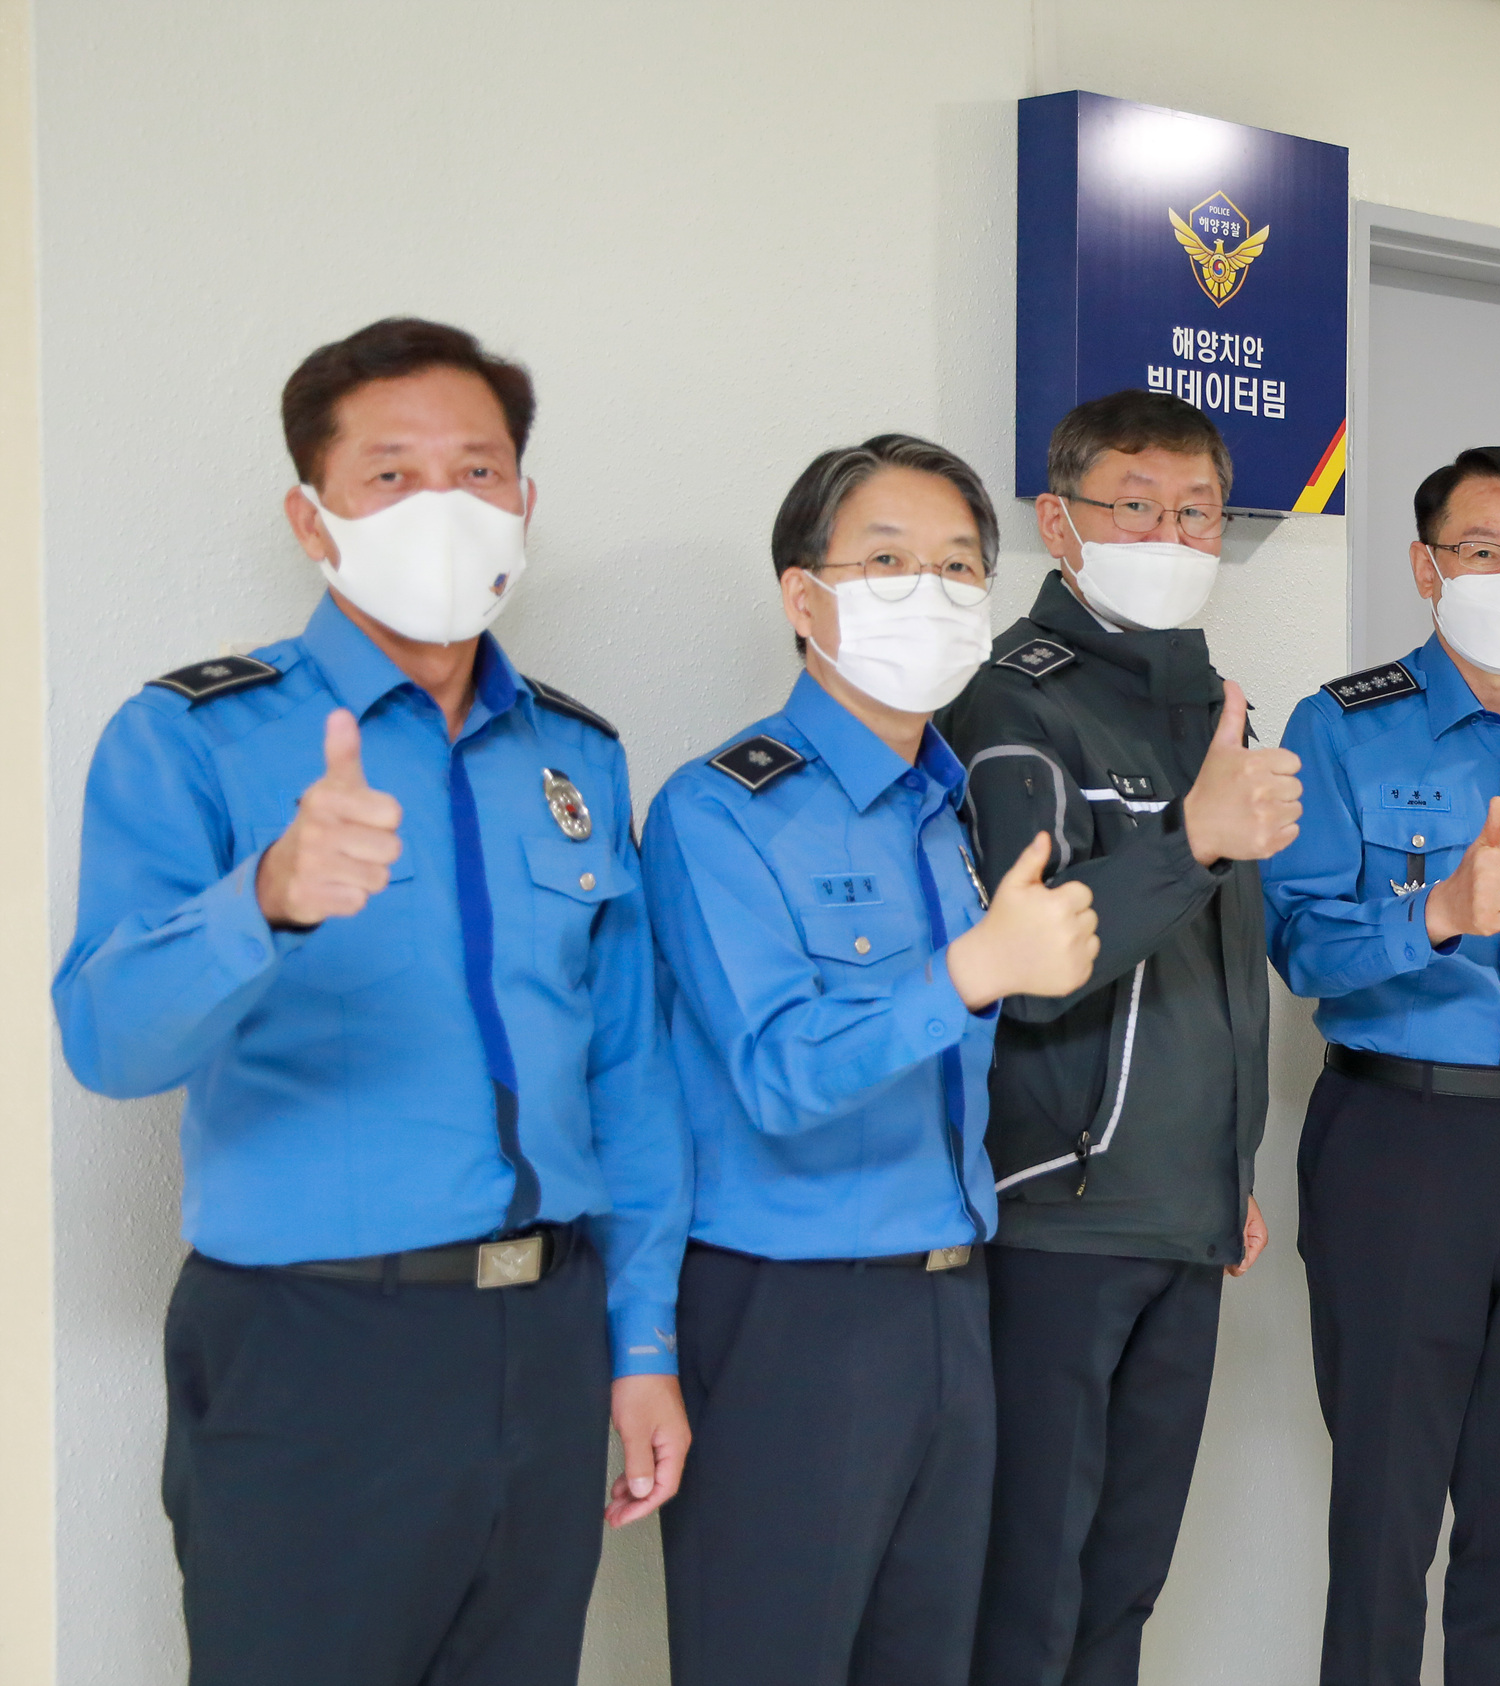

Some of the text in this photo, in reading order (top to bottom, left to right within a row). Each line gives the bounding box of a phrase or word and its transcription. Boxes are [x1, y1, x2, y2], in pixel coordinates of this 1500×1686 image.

[1209, 205, 1231, 217] POLICE
[1199, 216, 1241, 238] 해양경찰
[1172, 326, 1264, 369] 해양치안
